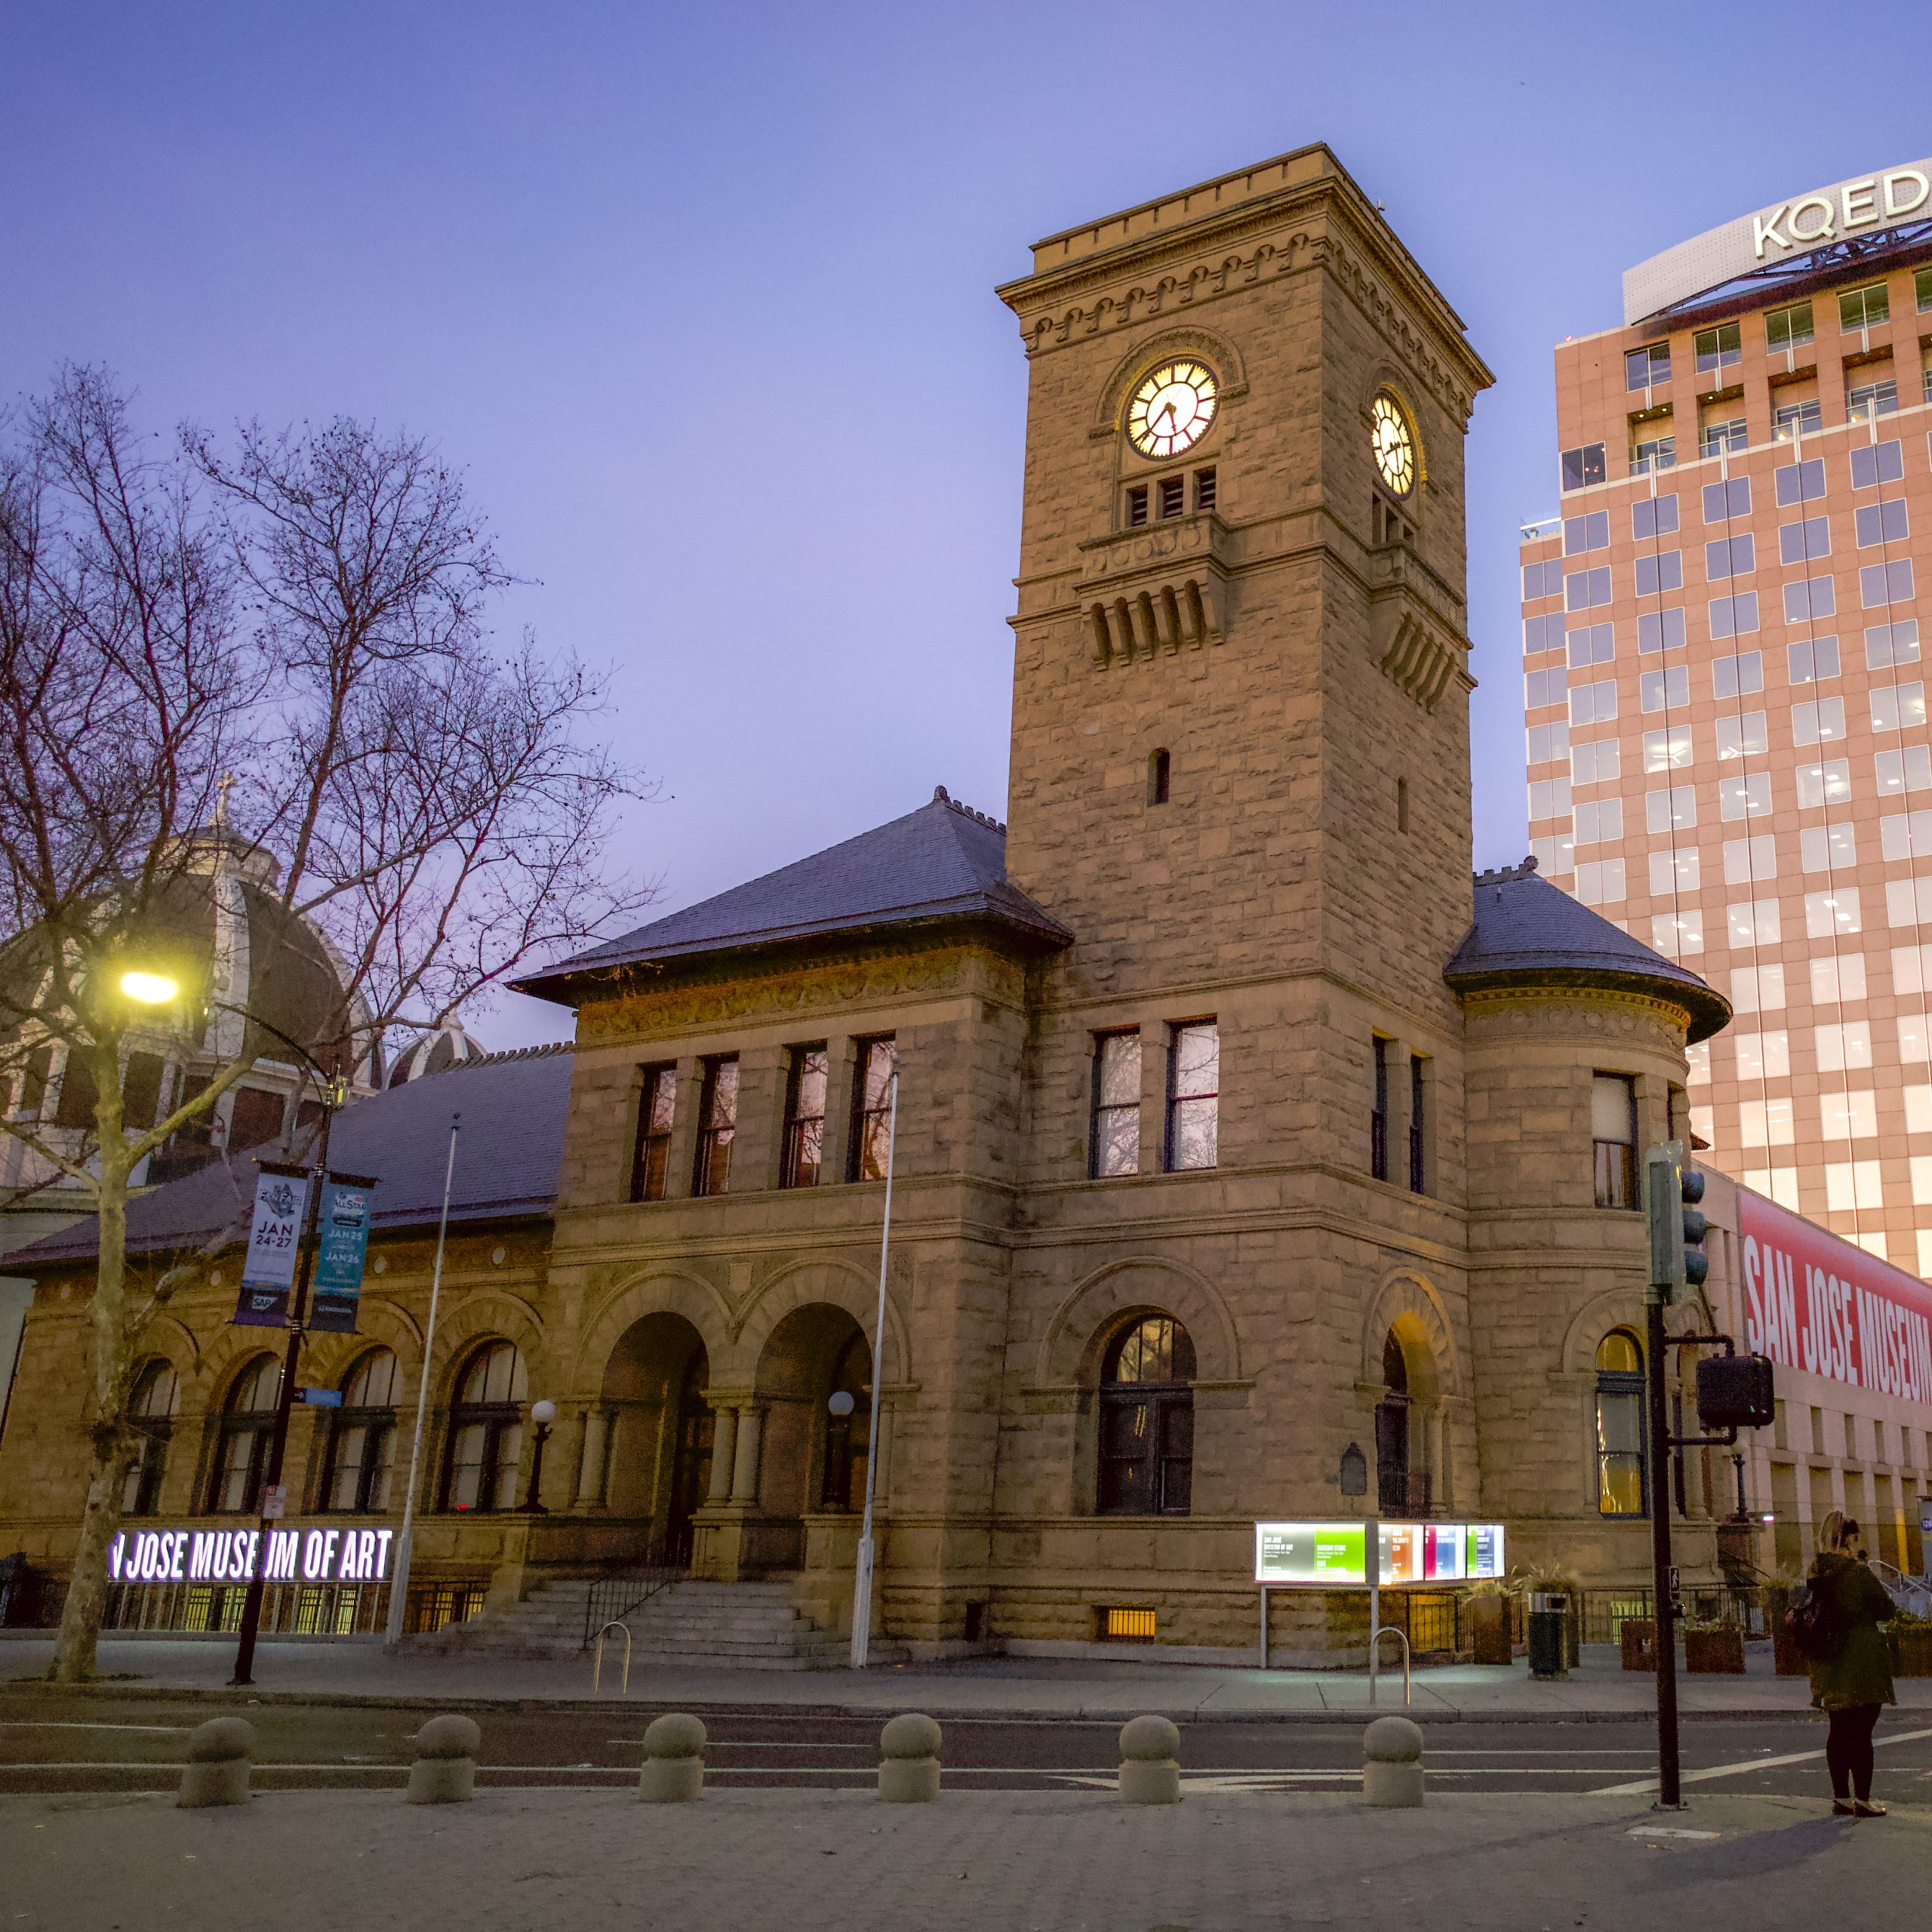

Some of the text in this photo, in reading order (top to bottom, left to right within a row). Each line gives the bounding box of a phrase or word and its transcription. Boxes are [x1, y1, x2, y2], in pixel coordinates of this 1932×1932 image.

[1753, 170, 1930, 260] KQED
[257, 1221, 294, 1236] JAN
[328, 1229, 363, 1241] JAN 25
[256, 1234, 292, 1248] 24-27
[325, 1252, 360, 1263] JAN 26
[254, 1298, 272, 1307] SAP
[1744, 1235, 1932, 1407] SAN JOSE MUSEUM
[125, 1531, 189, 1579] JOSE
[304, 1530, 340, 1579] OF
[339, 1530, 393, 1579] ART
